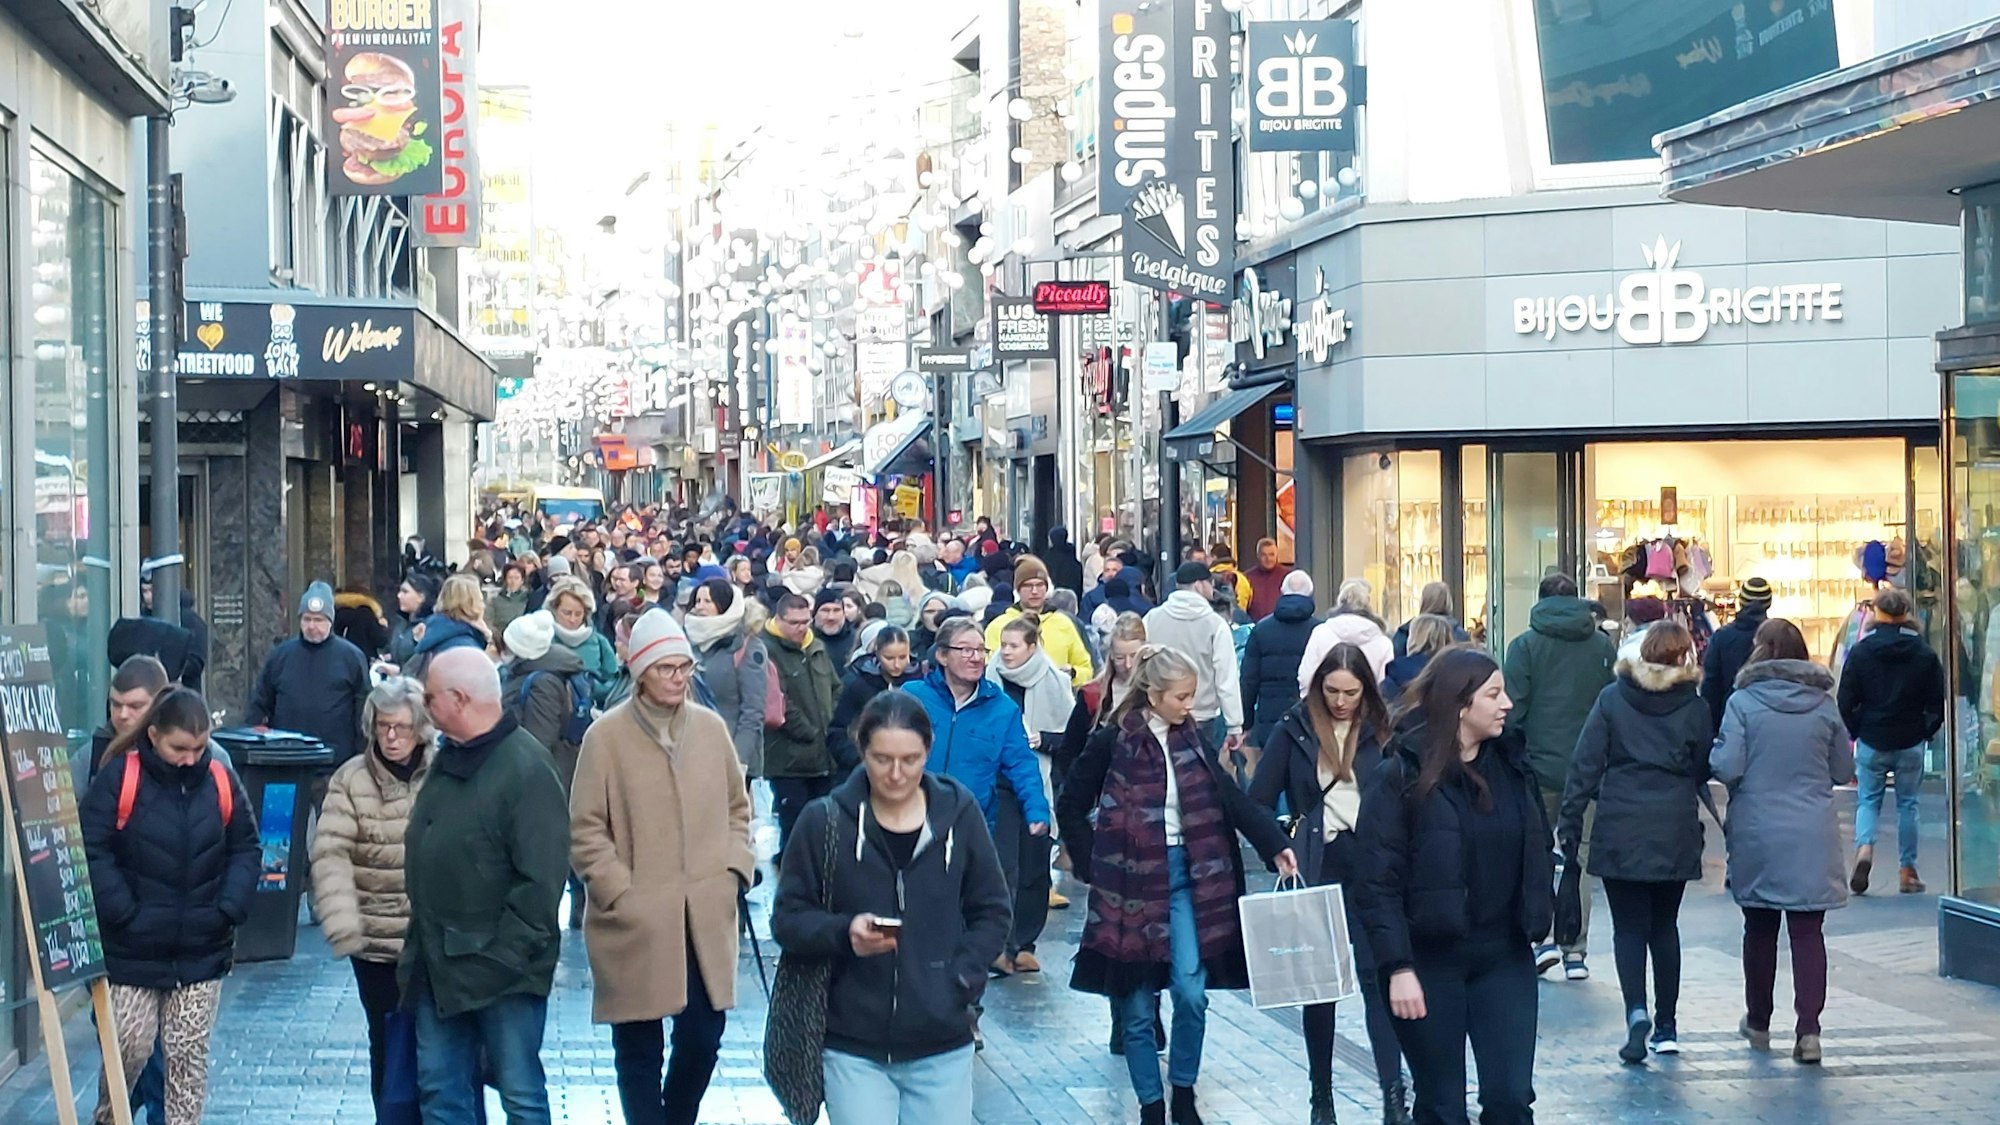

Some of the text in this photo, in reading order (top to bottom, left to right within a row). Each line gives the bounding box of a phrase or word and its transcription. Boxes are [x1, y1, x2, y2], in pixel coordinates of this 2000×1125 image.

[331, 0, 432, 30] BURGER
[1112, 33, 1176, 187] snipes
[1192, 0, 1220, 267] FRITES
[1260, 118, 1342, 133] BIJOU BRIGITTE
[1131, 251, 1227, 295] Belgique
[1036, 284, 1108, 304] Piccadly
[200, 303, 224, 321] WE
[998, 304, 1049, 320] LUS
[1513, 296, 1616, 341] BIJOU
[998, 319, 1049, 334] FRESH
[174, 353, 255, 375] TREETFOOD
